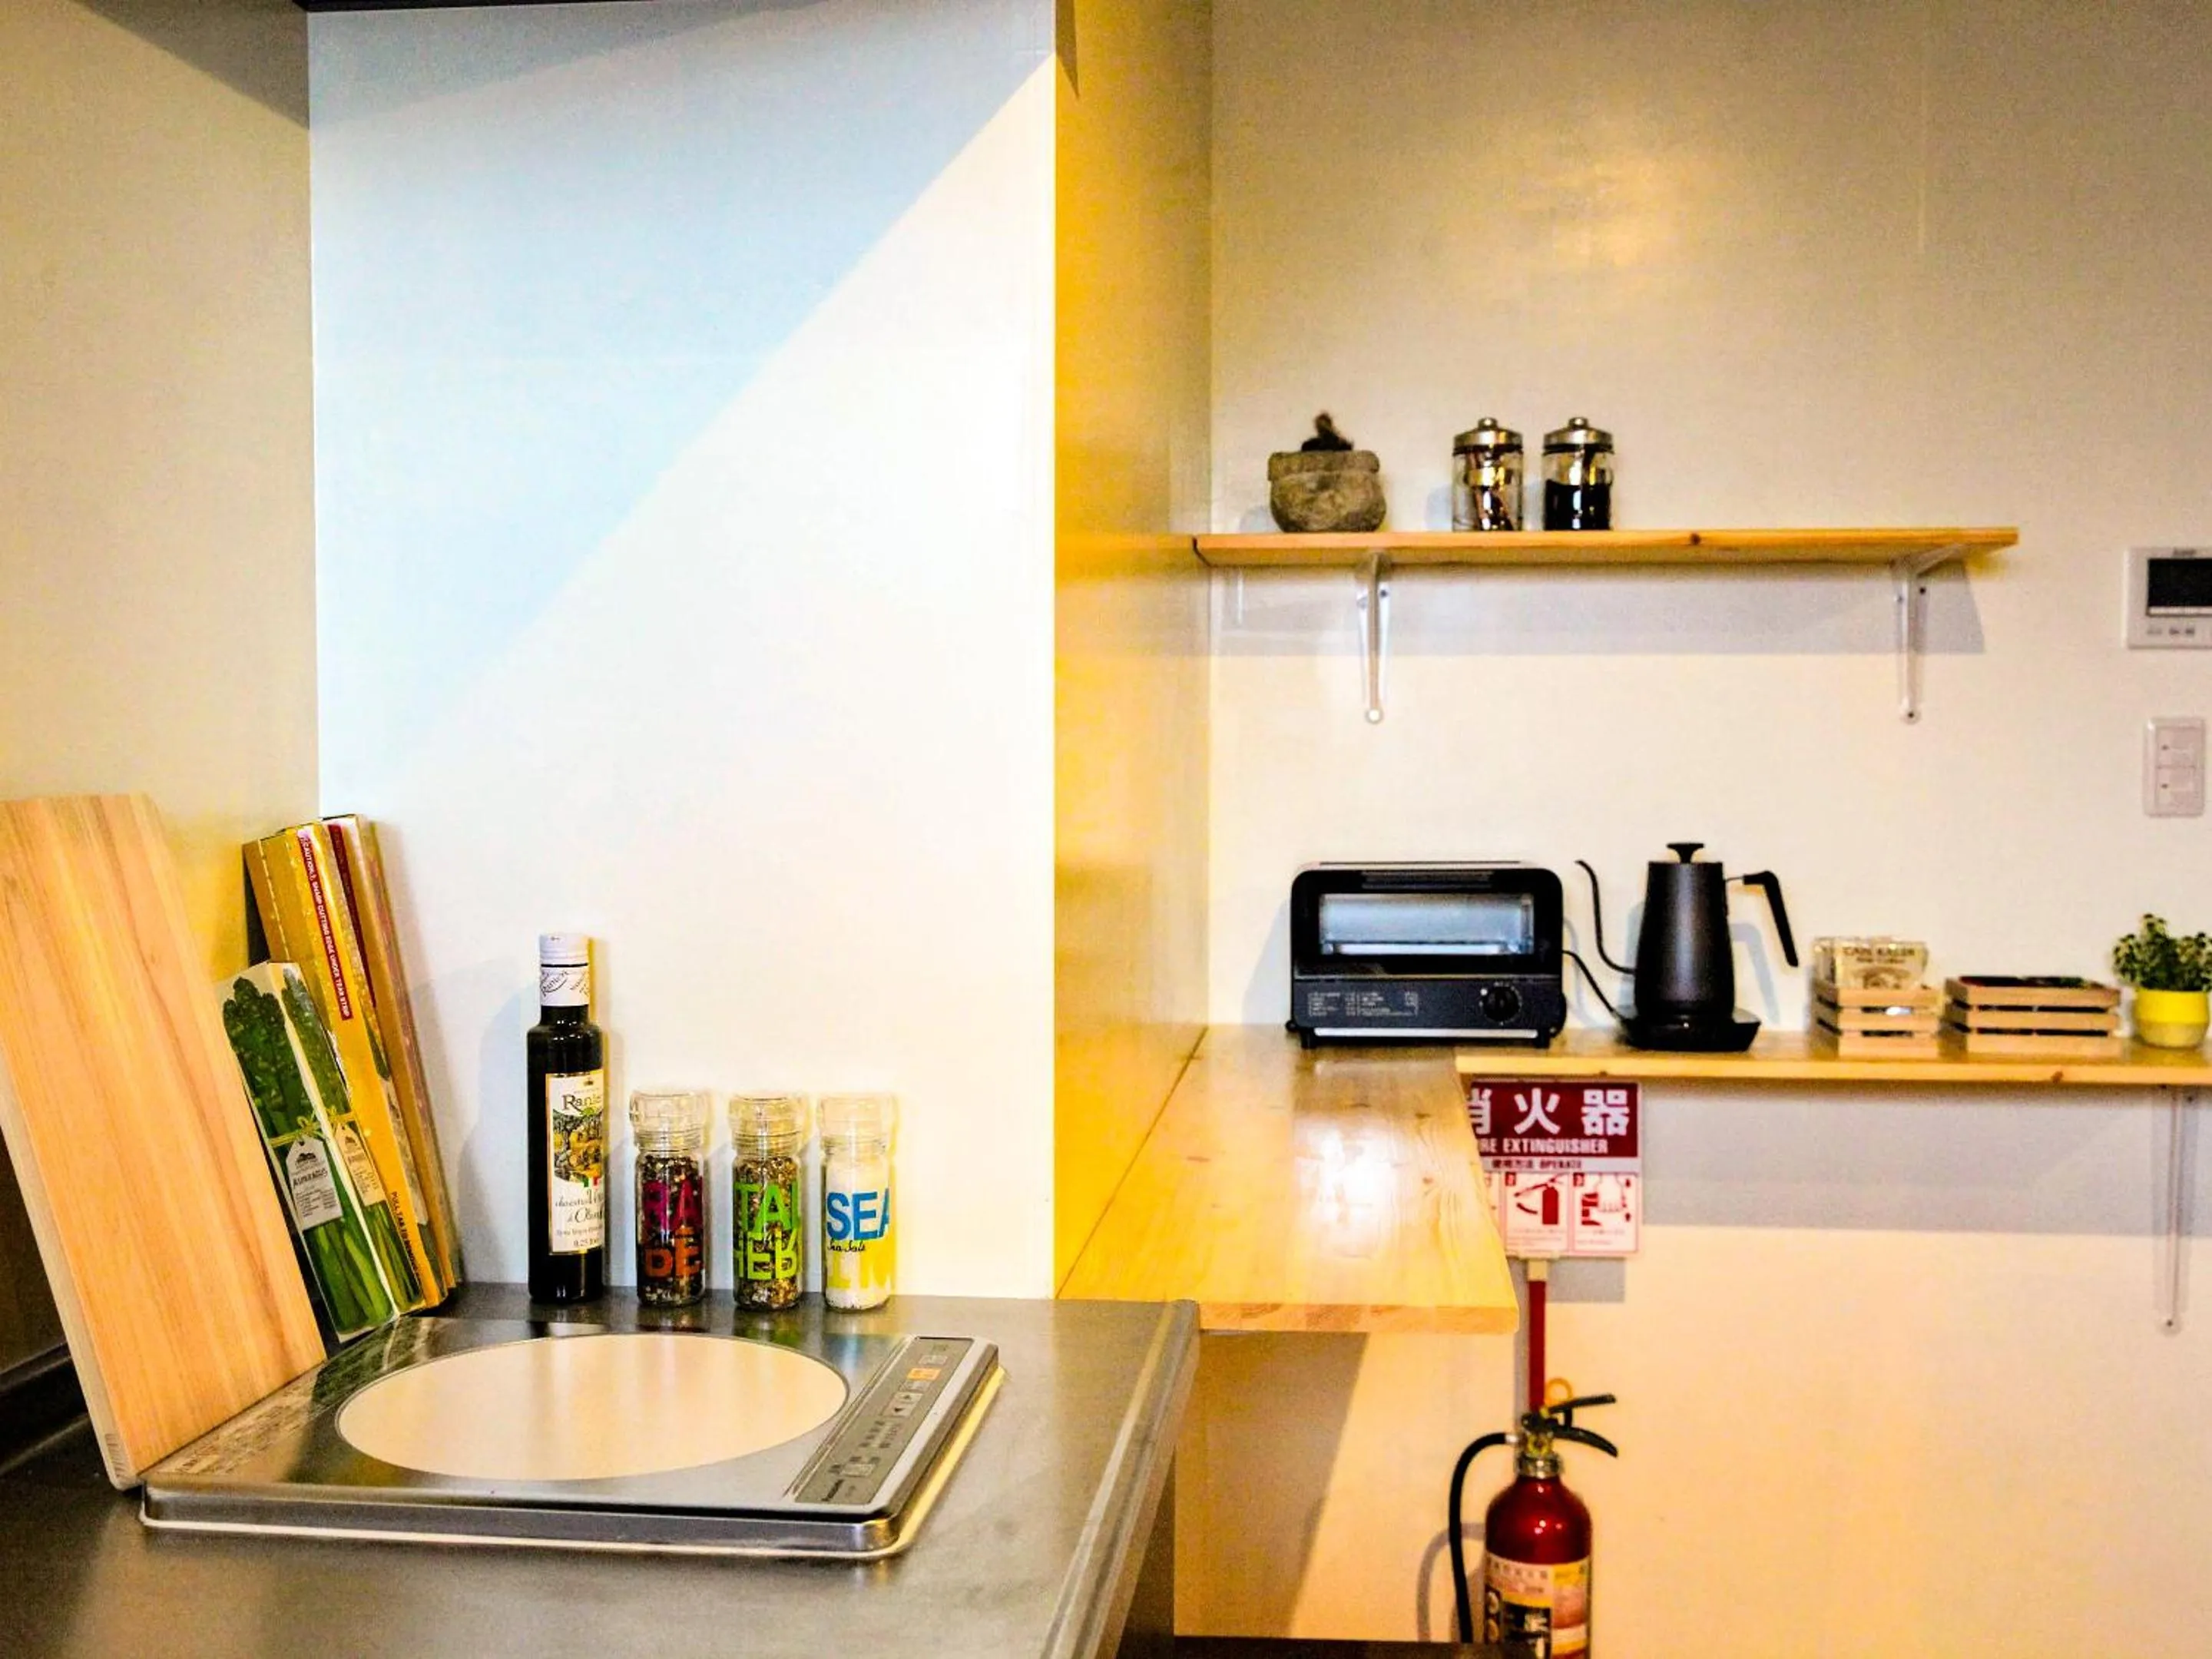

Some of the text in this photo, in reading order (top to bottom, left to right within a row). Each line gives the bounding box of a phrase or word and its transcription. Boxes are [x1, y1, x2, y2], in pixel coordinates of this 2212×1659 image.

[316, 904, 331, 935] CUTTING
[324, 935, 336, 954] EDGE
[329, 954, 342, 978] UNDER
[335, 978, 346, 996] TEAR
[339, 996, 352, 1017] STRIP
[1479, 1138, 1608, 1154] RE EXTINGUISHER
